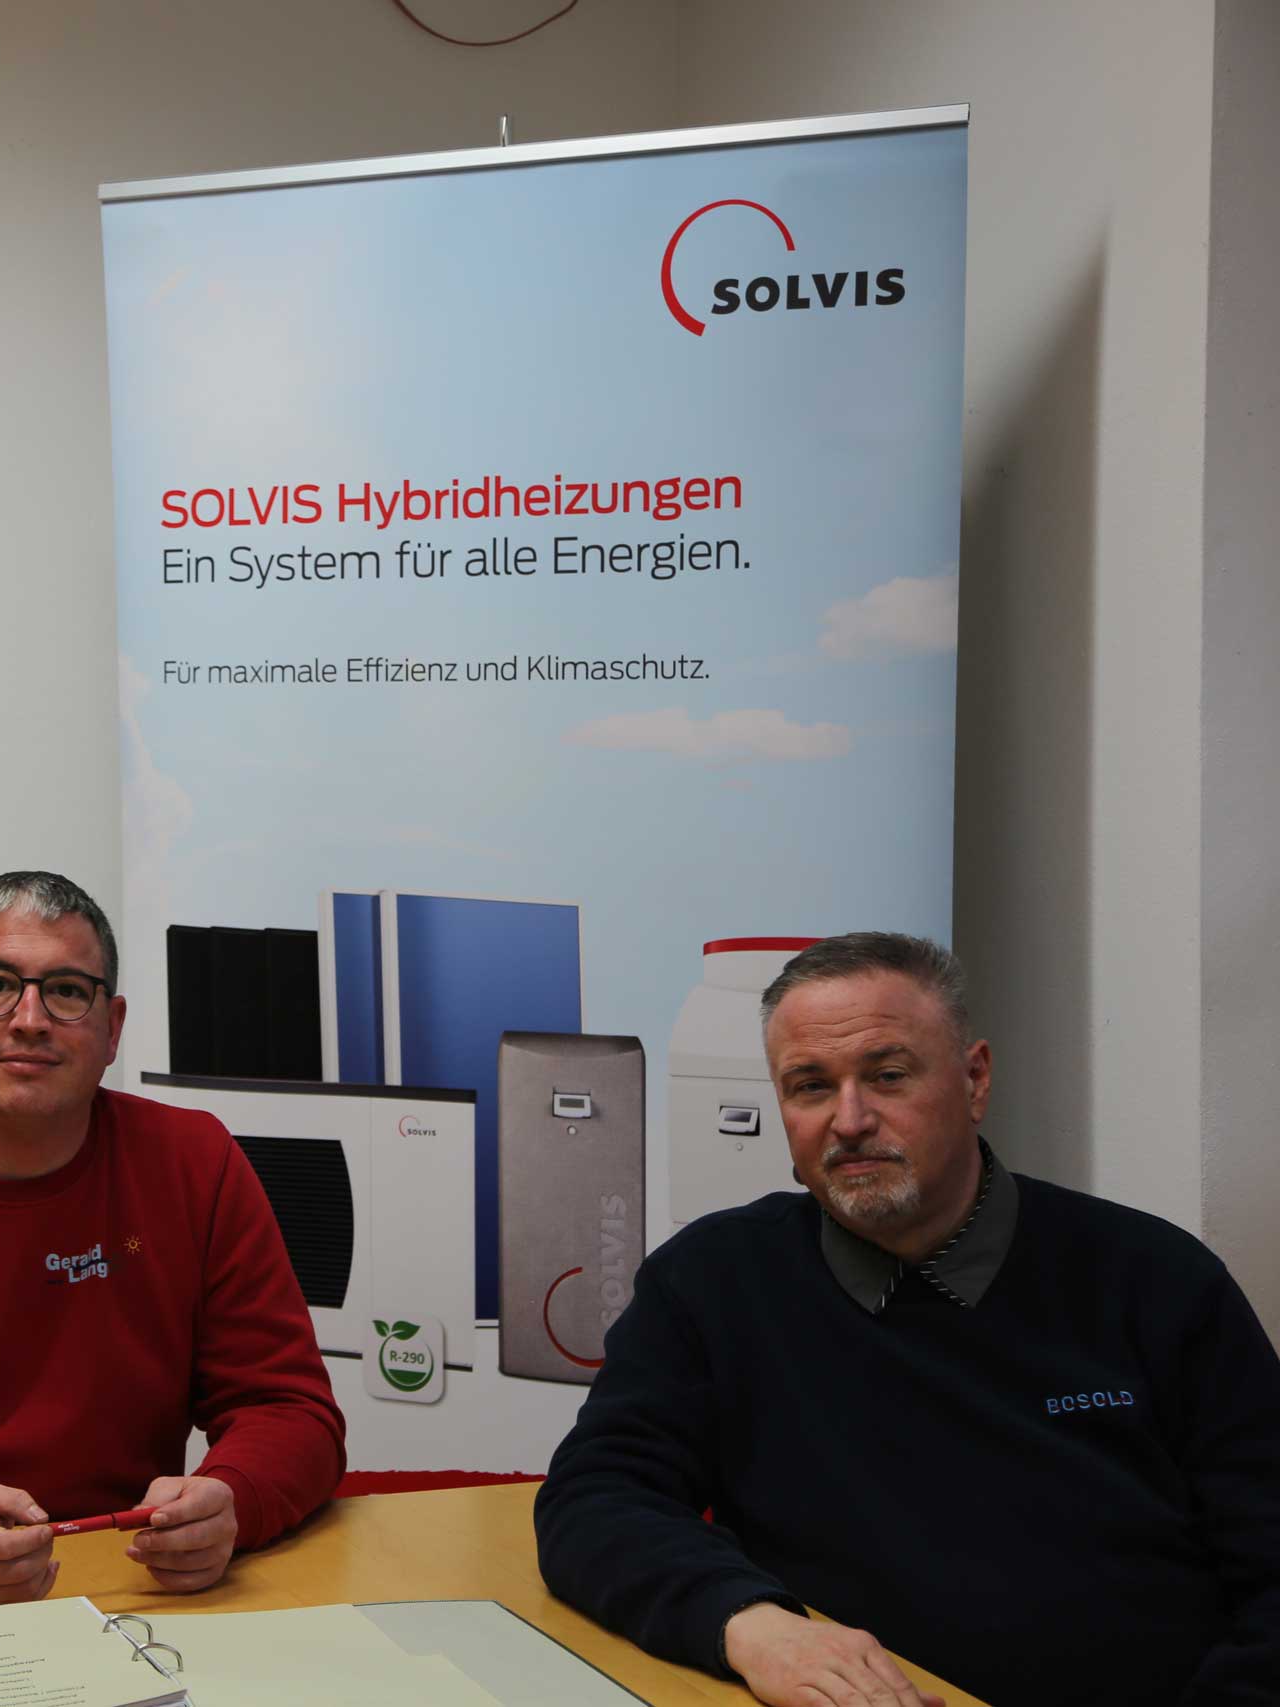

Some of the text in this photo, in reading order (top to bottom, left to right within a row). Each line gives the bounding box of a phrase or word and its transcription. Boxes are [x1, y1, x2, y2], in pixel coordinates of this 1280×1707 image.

[711, 268, 906, 315] SOLVIS
[161, 474, 741, 530] SOLVIS Hybridheizungen
[163, 533, 751, 590] Ein System für alle Energien.
[163, 653, 710, 684] Für maximale Effizienz und Klimaschutz.
[407, 1128, 437, 1137] SOLVIS
[45, 1243, 102, 1272] Gerald
[389, 1350, 425, 1365] R-290
[1046, 1391, 1134, 1414] BOSOLD
